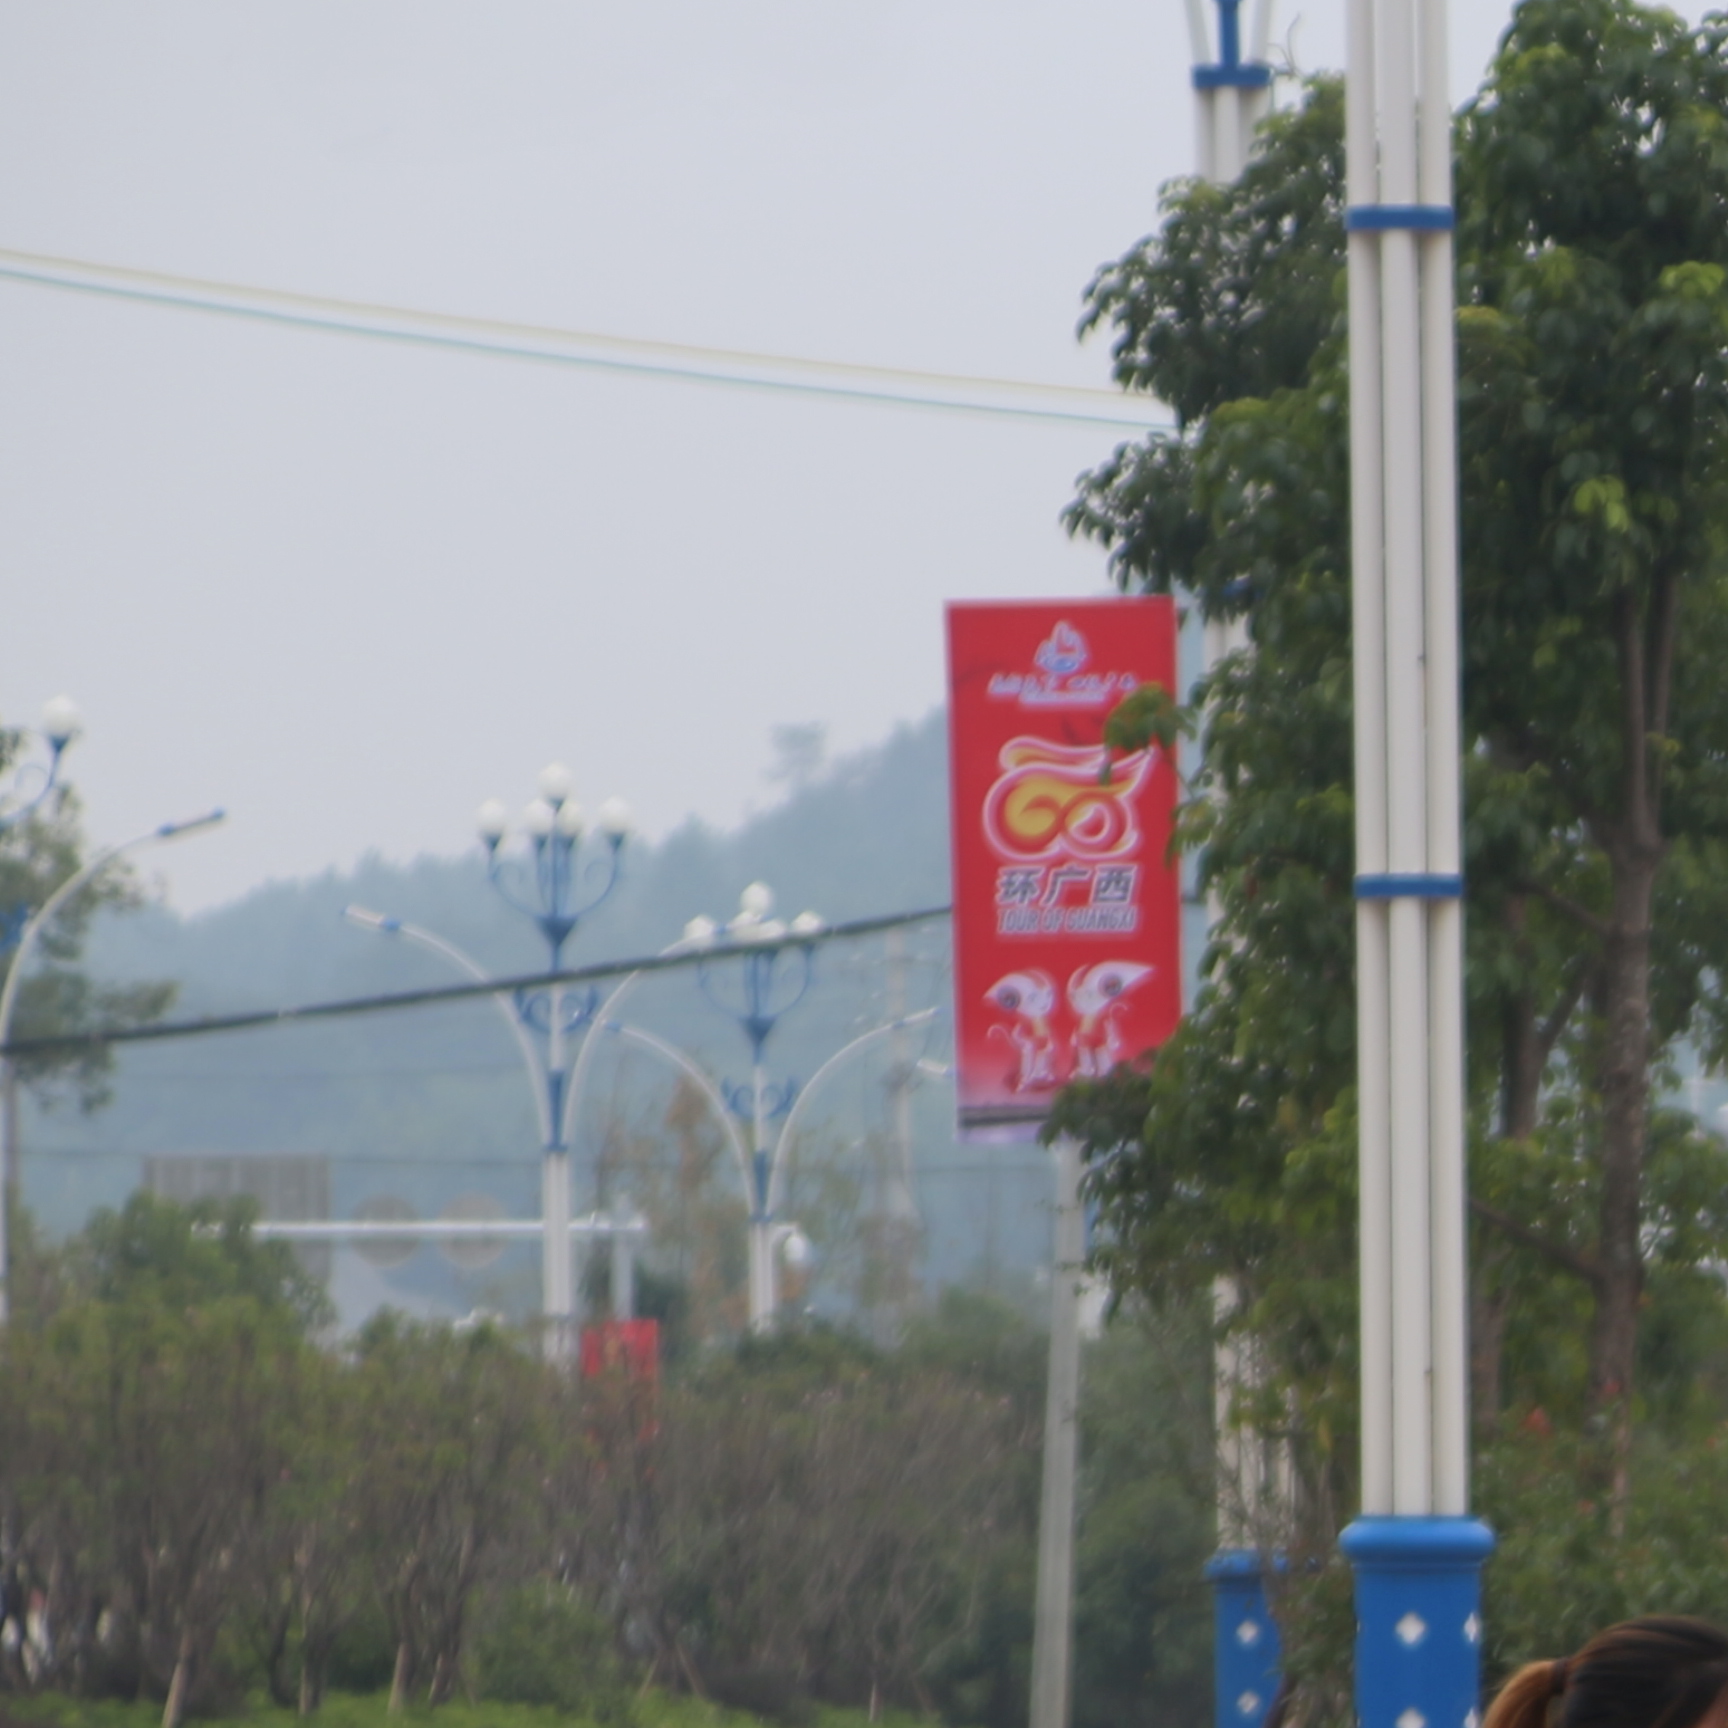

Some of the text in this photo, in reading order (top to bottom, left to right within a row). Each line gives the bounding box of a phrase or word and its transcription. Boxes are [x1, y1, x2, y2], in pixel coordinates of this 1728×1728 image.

[996, 864, 1137, 905] 环广西
[998, 906, 1137, 932] TOUR OF GUANGXI
